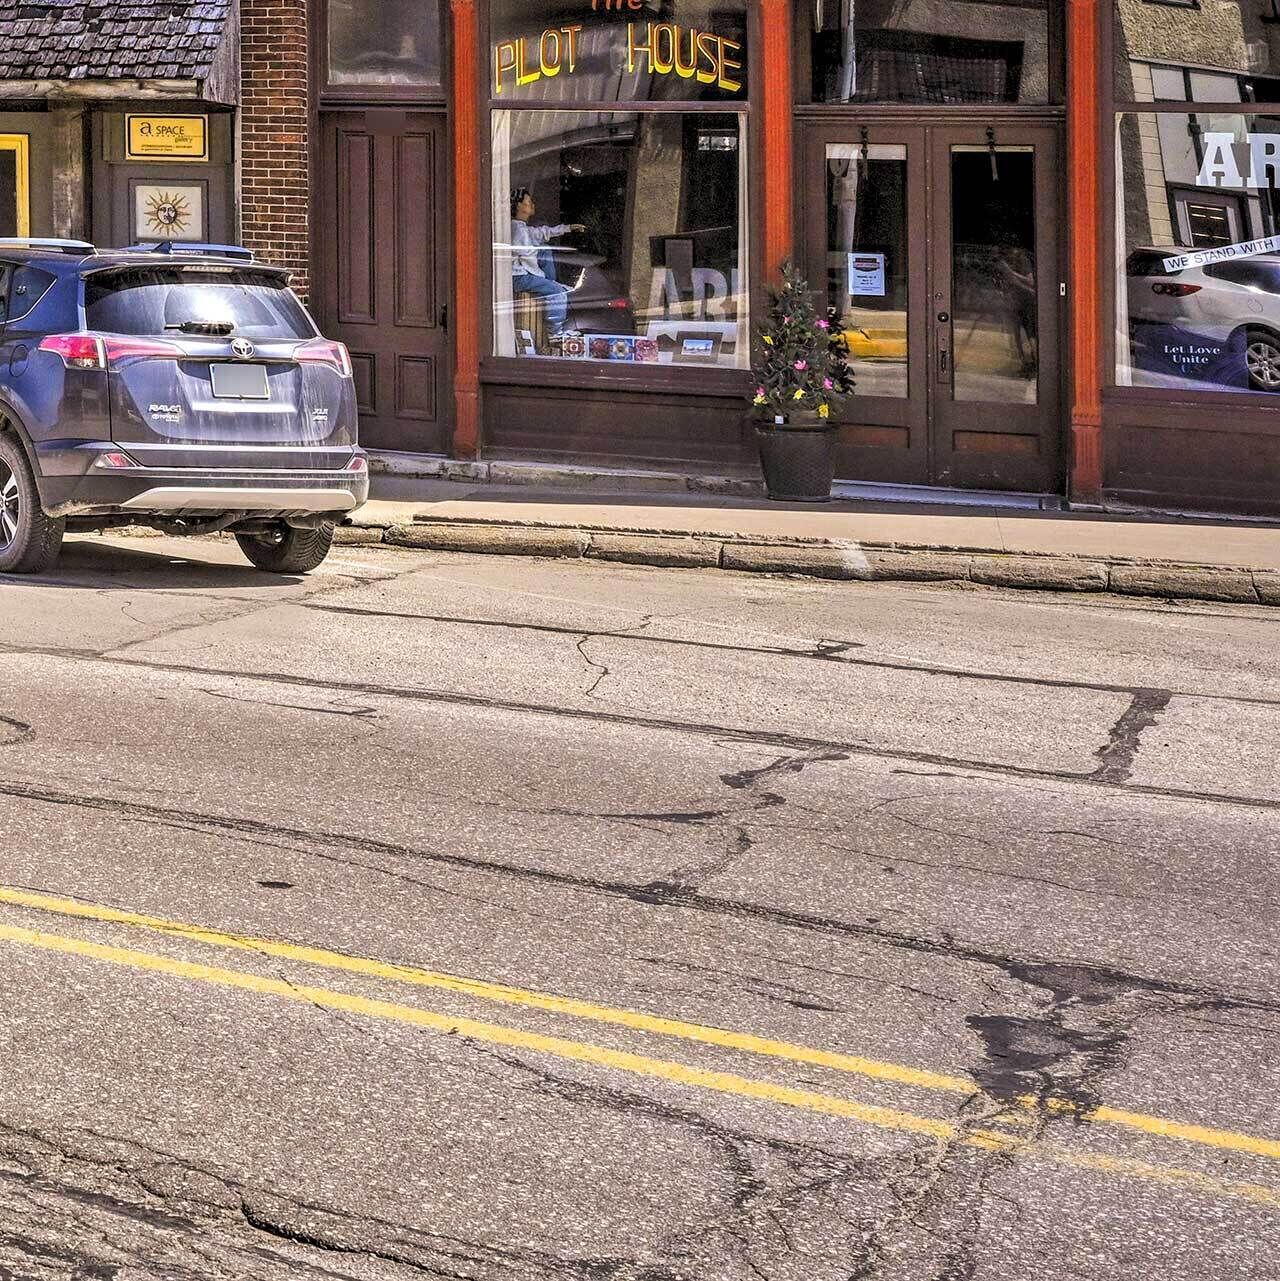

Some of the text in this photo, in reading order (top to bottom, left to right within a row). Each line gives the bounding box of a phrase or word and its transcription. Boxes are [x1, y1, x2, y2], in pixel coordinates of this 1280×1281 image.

[495, 21, 742, 94] PILOT HOUSE
[140, 121, 185, 135] a SPACE
[1196, 132, 1280, 188] AR
[1167, 238, 1275, 269] WE STAND WITH
[1164, 345, 1221, 355] Let Love
[1172, 355, 1209, 364] Unite
